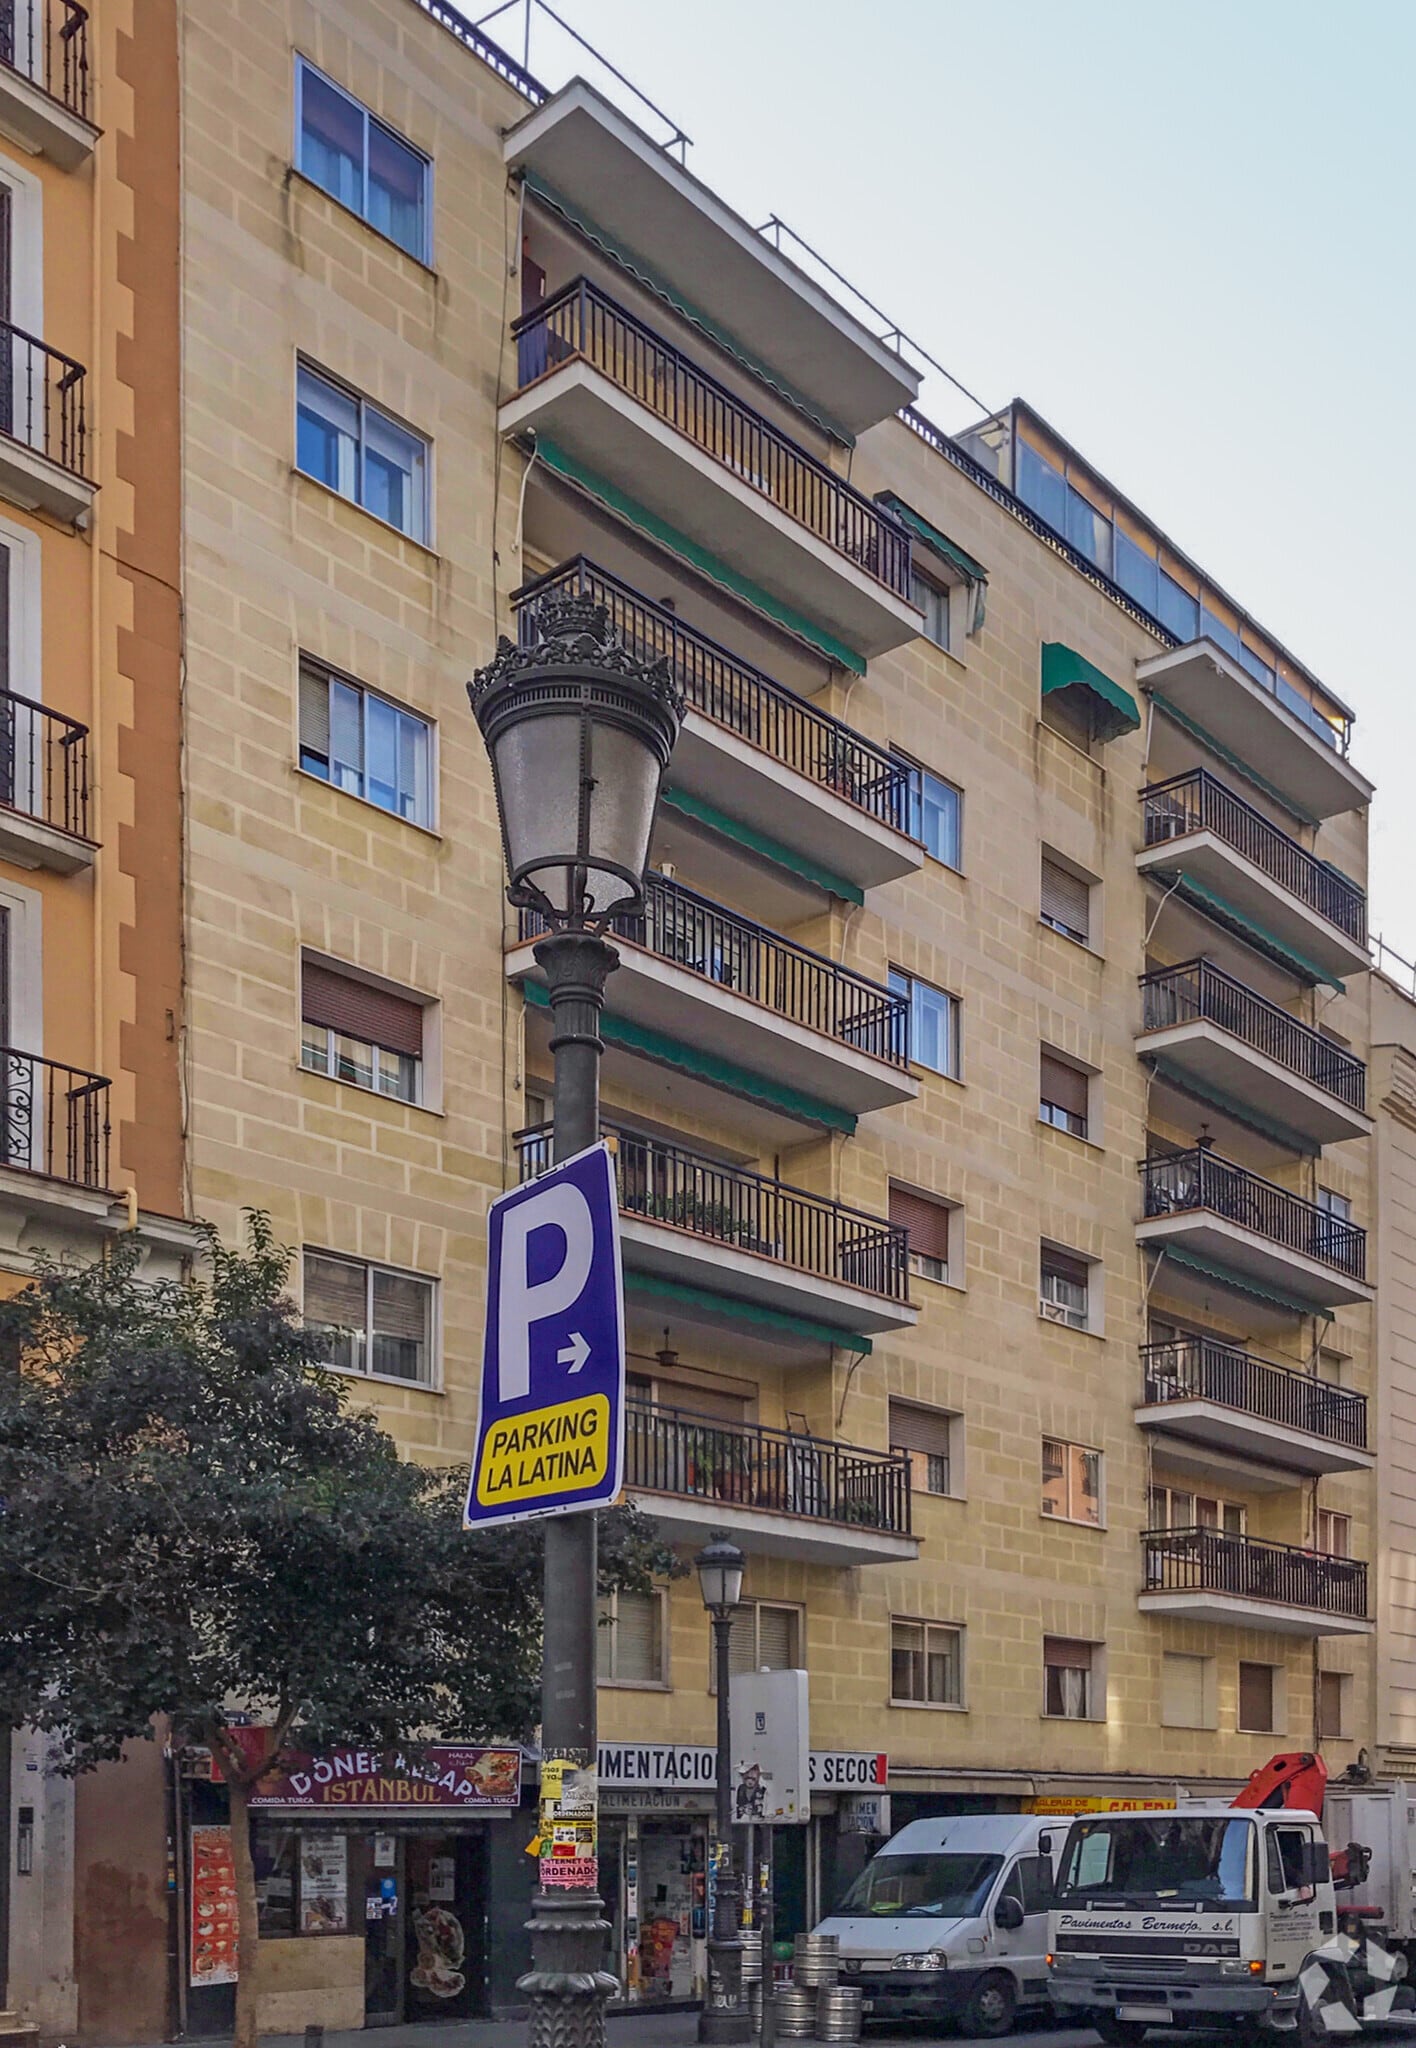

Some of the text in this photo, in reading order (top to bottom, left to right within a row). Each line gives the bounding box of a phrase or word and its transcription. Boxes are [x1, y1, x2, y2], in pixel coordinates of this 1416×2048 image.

[499, 1182, 594, 1403] P
[492, 1408, 598, 1458] PARKING
[486, 1446, 597, 1493] LA LATINA
[598, 1749, 718, 1781] IMENTACIO
[823, 1757, 878, 1783] SECOS
[322, 1778, 441, 1803] ISTANBUL
[1059, 1914, 1132, 1929] Pavimentos
[1183, 1942, 1238, 1954] DAF
